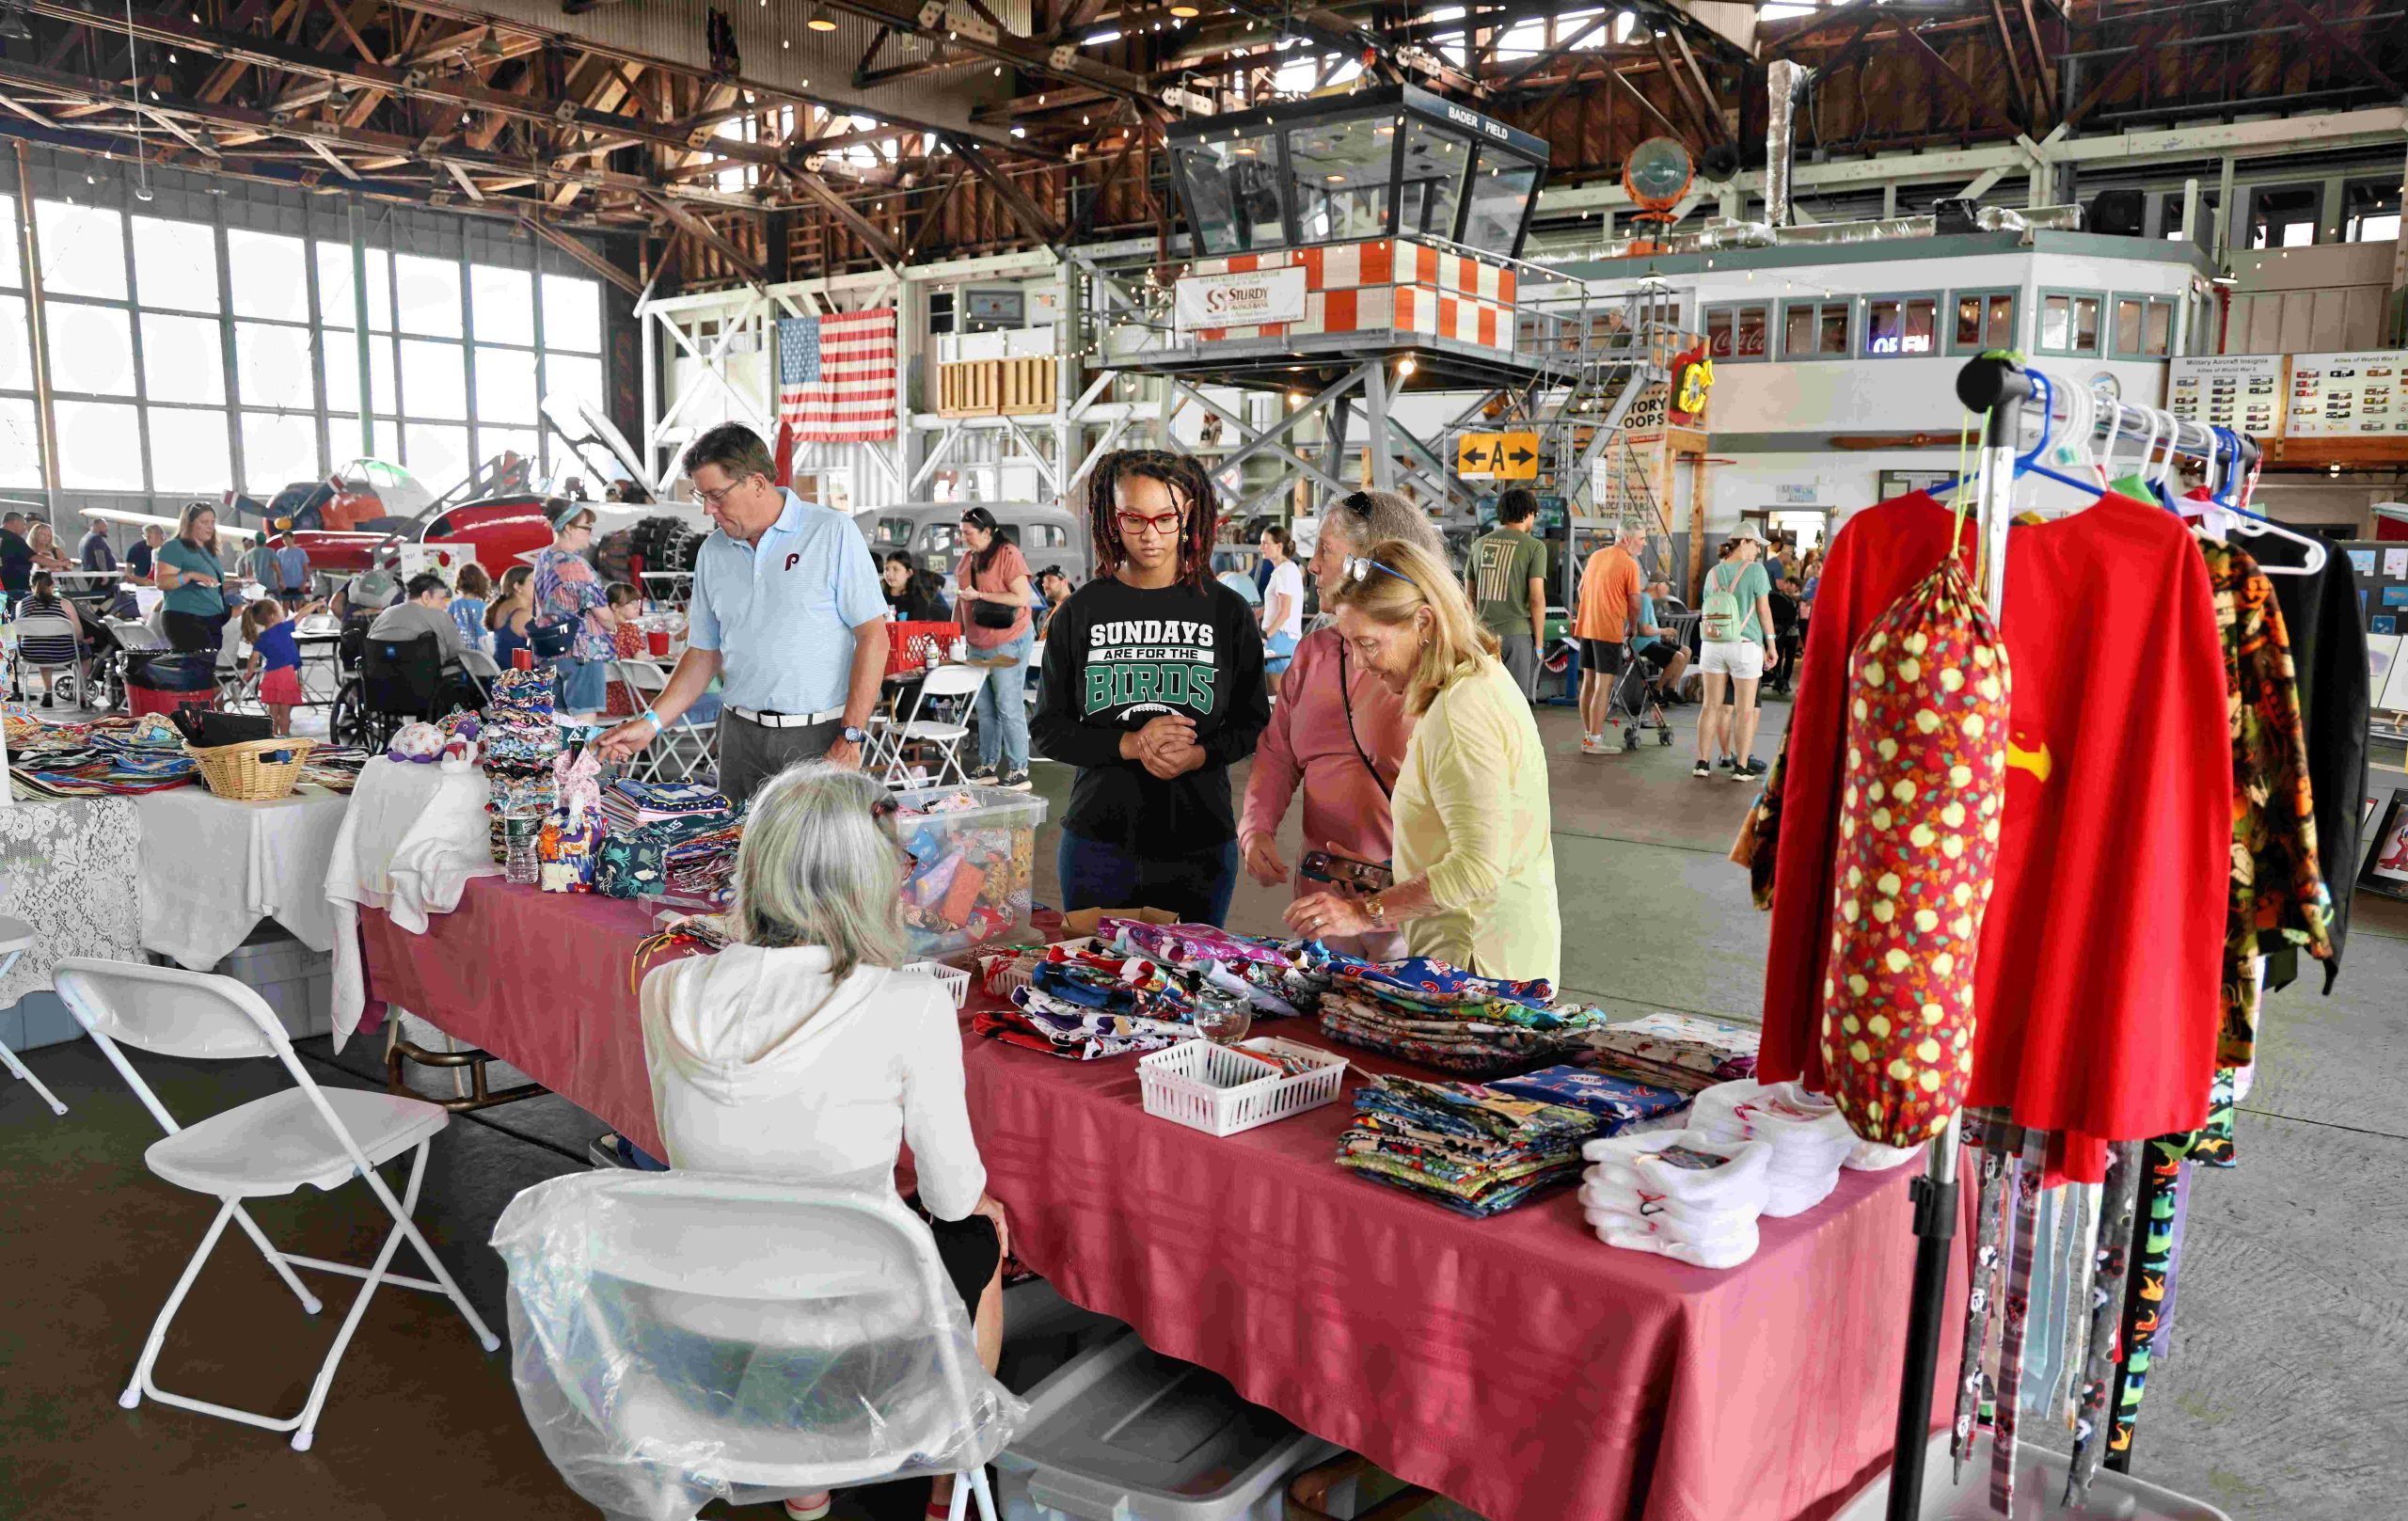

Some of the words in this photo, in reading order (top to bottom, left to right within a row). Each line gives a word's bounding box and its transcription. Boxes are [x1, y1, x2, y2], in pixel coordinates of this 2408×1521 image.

[1449, 106, 1478, 128] BADER
[1485, 120, 1508, 139] FIELD
[1229, 286, 1270, 301] STURDY
[1631, 398, 1667, 414] TORY
[1624, 413, 1665, 429] OOPS
[1489, 440, 1505, 471] A
[1485, 537, 1519, 546] FREEDOM
[1090, 621, 1213, 646] SUNDAYS
[1103, 648, 1133, 659] ARE
[1136, 648, 1165, 658] FOR
[1168, 648, 1198, 658] THE
[1083, 663, 1220, 716] BIRDS
